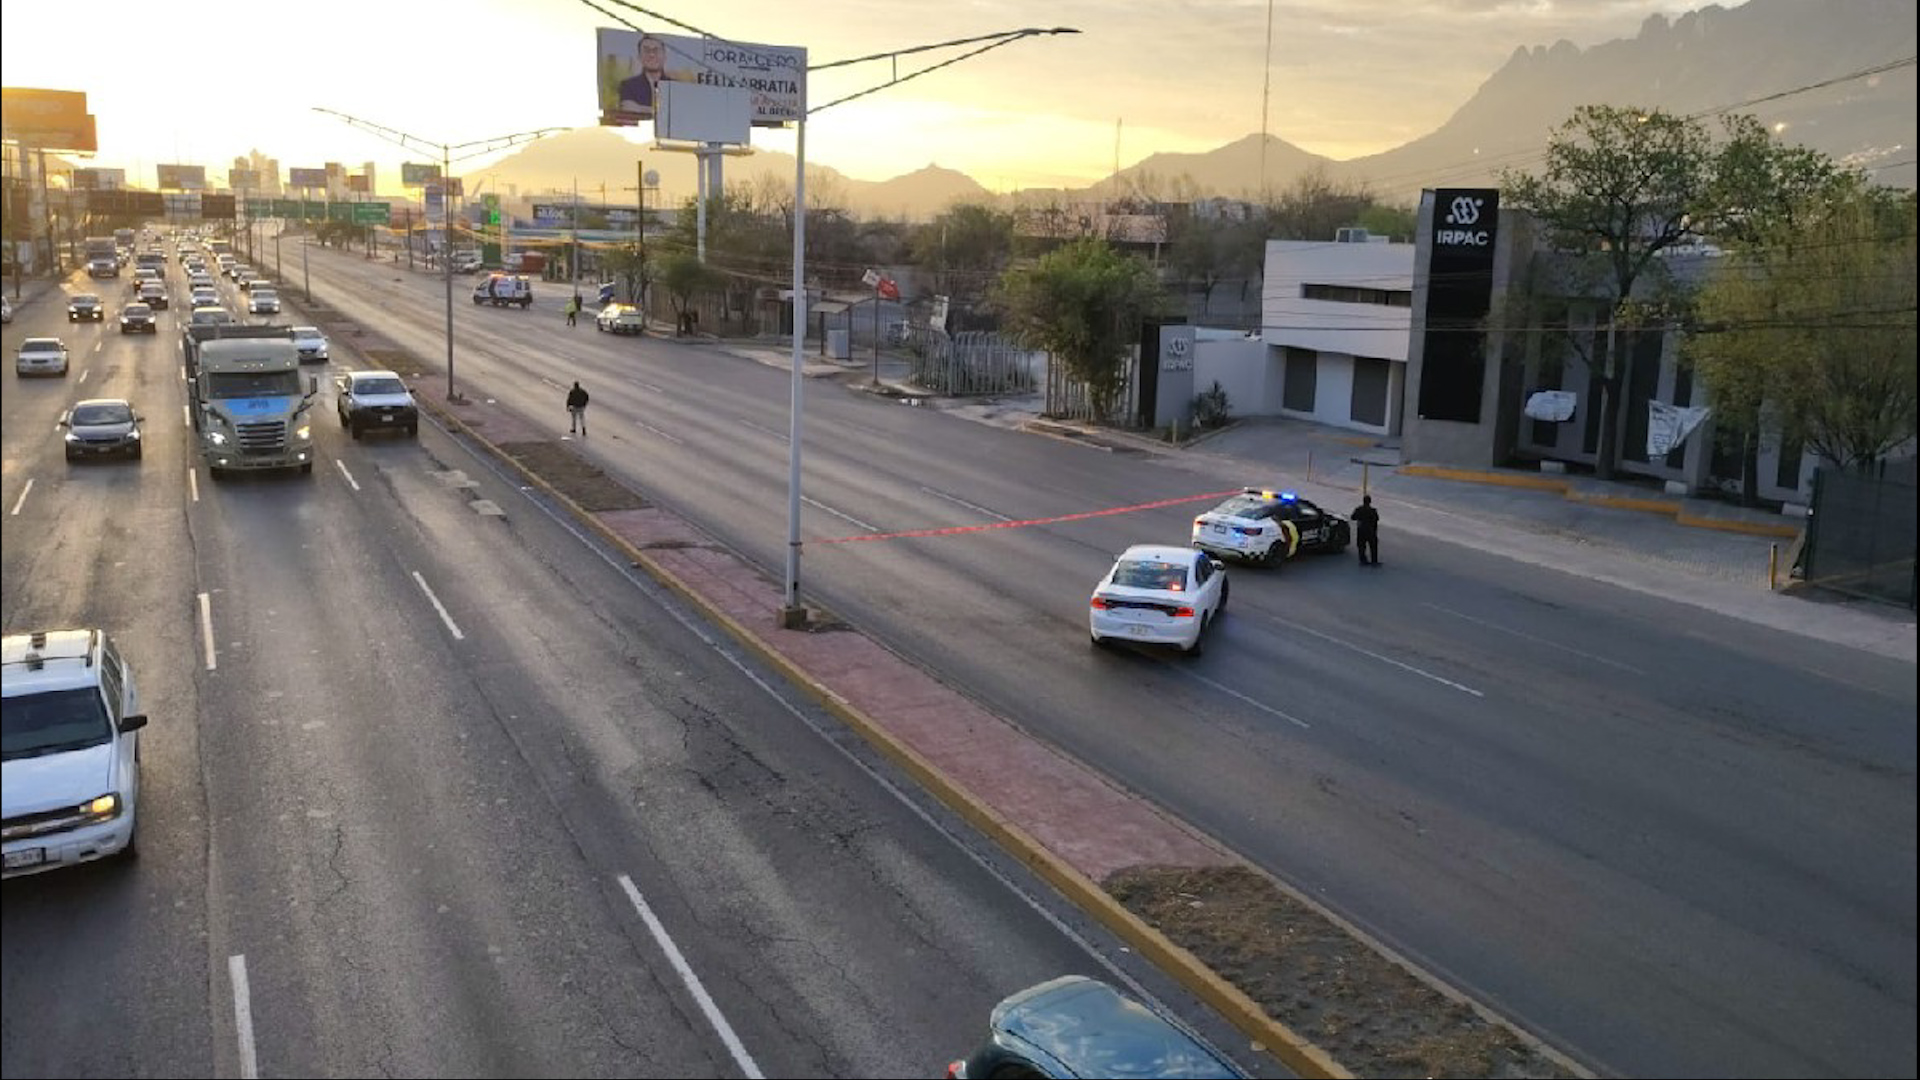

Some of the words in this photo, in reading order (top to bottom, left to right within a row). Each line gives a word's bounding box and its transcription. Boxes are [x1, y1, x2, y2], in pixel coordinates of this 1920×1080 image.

[704, 47, 748, 64] HORA
[754, 53, 798, 68] CERO
[697, 69, 736, 88] FÉLIX
[738, 77, 798, 94] ARRATIA
[1437, 230, 1488, 245] IRPAC
